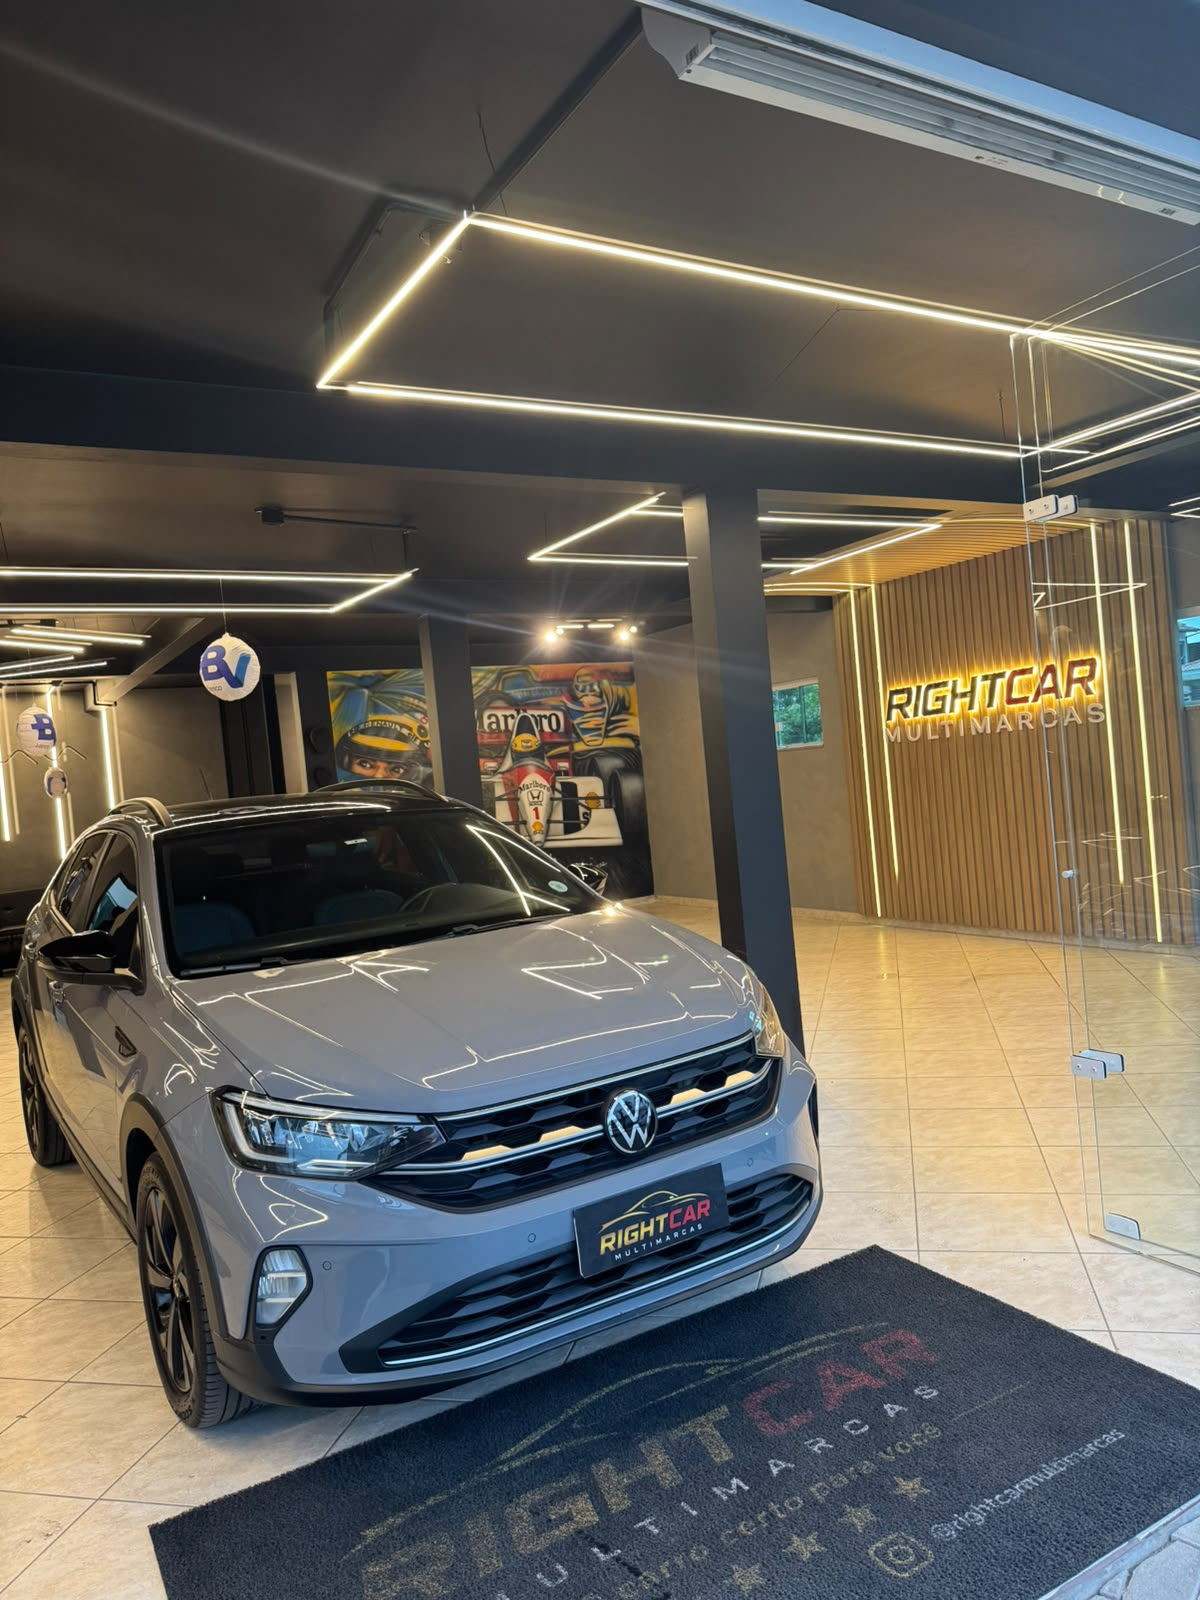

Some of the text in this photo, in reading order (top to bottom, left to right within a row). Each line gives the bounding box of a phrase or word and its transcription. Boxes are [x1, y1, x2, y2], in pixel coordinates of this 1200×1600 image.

[200, 645, 252, 689] BV
[887, 657, 1098, 722] RIGHTCAR
[885, 703, 1106, 744] MULTIMARCAS
[599, 1199, 711, 1256] RIGHTCAR
[614, 1223, 704, 1261] MULTIMARCAS
